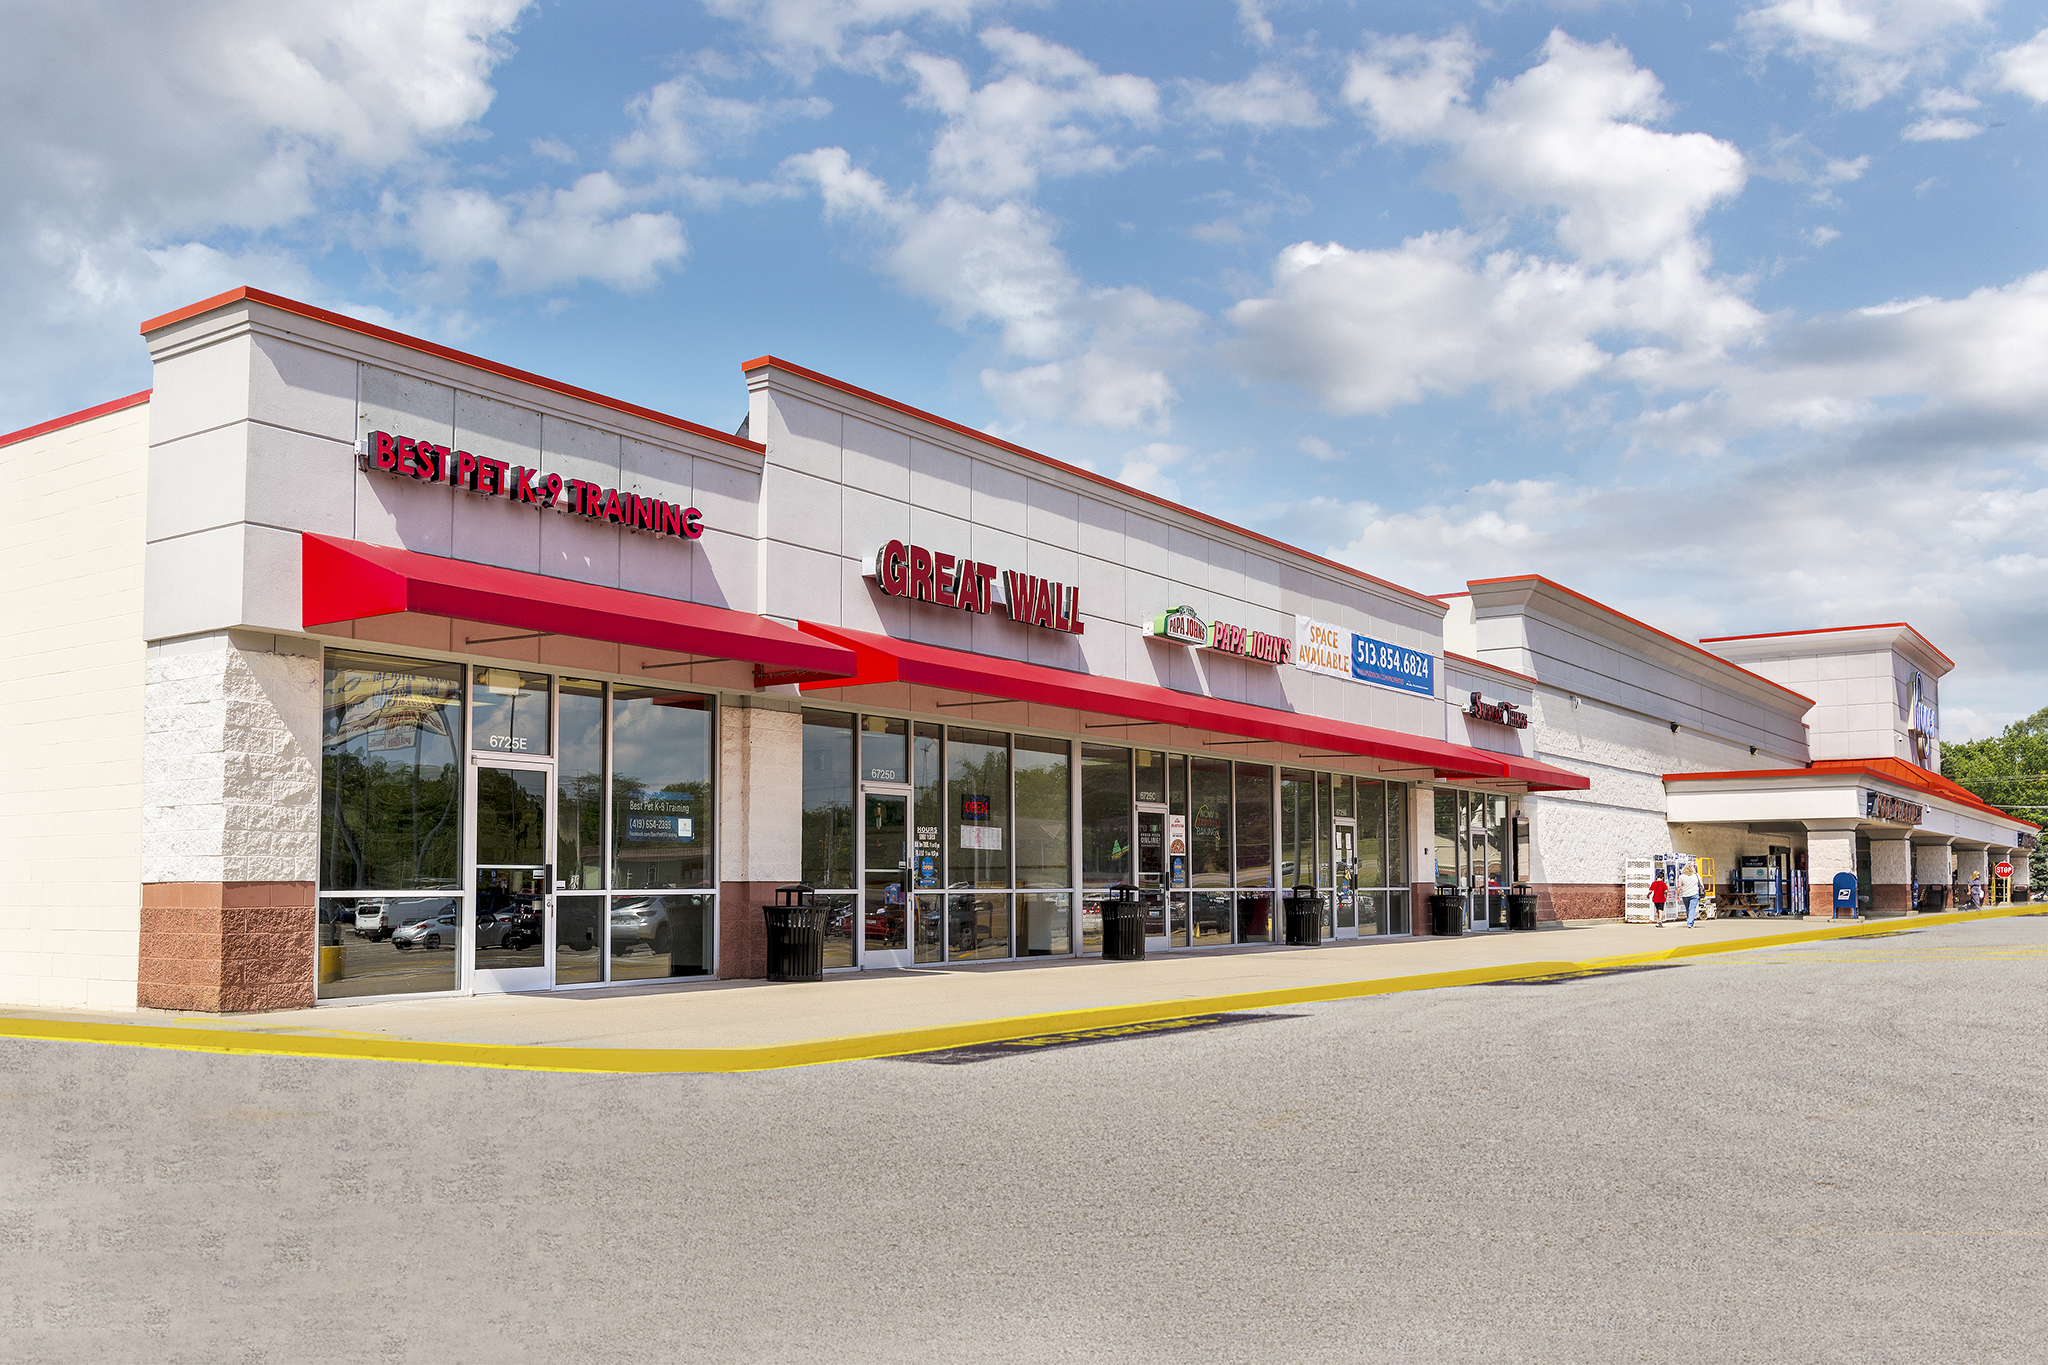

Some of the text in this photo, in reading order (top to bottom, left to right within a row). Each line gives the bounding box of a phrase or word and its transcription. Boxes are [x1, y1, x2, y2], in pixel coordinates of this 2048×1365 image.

[370, 430, 705, 540] BEST PET K-9 TRAINING
[877, 539, 1085, 635] GREAT WALL
[1169, 616, 1185, 635] PAPA
[1212, 620, 1292, 665] PAPA JOHN'S
[1310, 625, 1339, 650] SPACE
[1299, 645, 1349, 673] AVAILABLE
[1357, 640, 1429, 679] 513.854.6824
[489, 735, 528, 750] 6725E
[871, 768, 896, 780] 6725D
[629, 800, 643, 811] Best
[644, 801, 654, 811] Pet
[666, 802, 690, 814] Training
[965, 801, 988, 814] OPEN
[629, 818, 645, 829] (419)
[917, 826, 938, 834] HOURS
[1996, 866, 2012, 874] STOP
